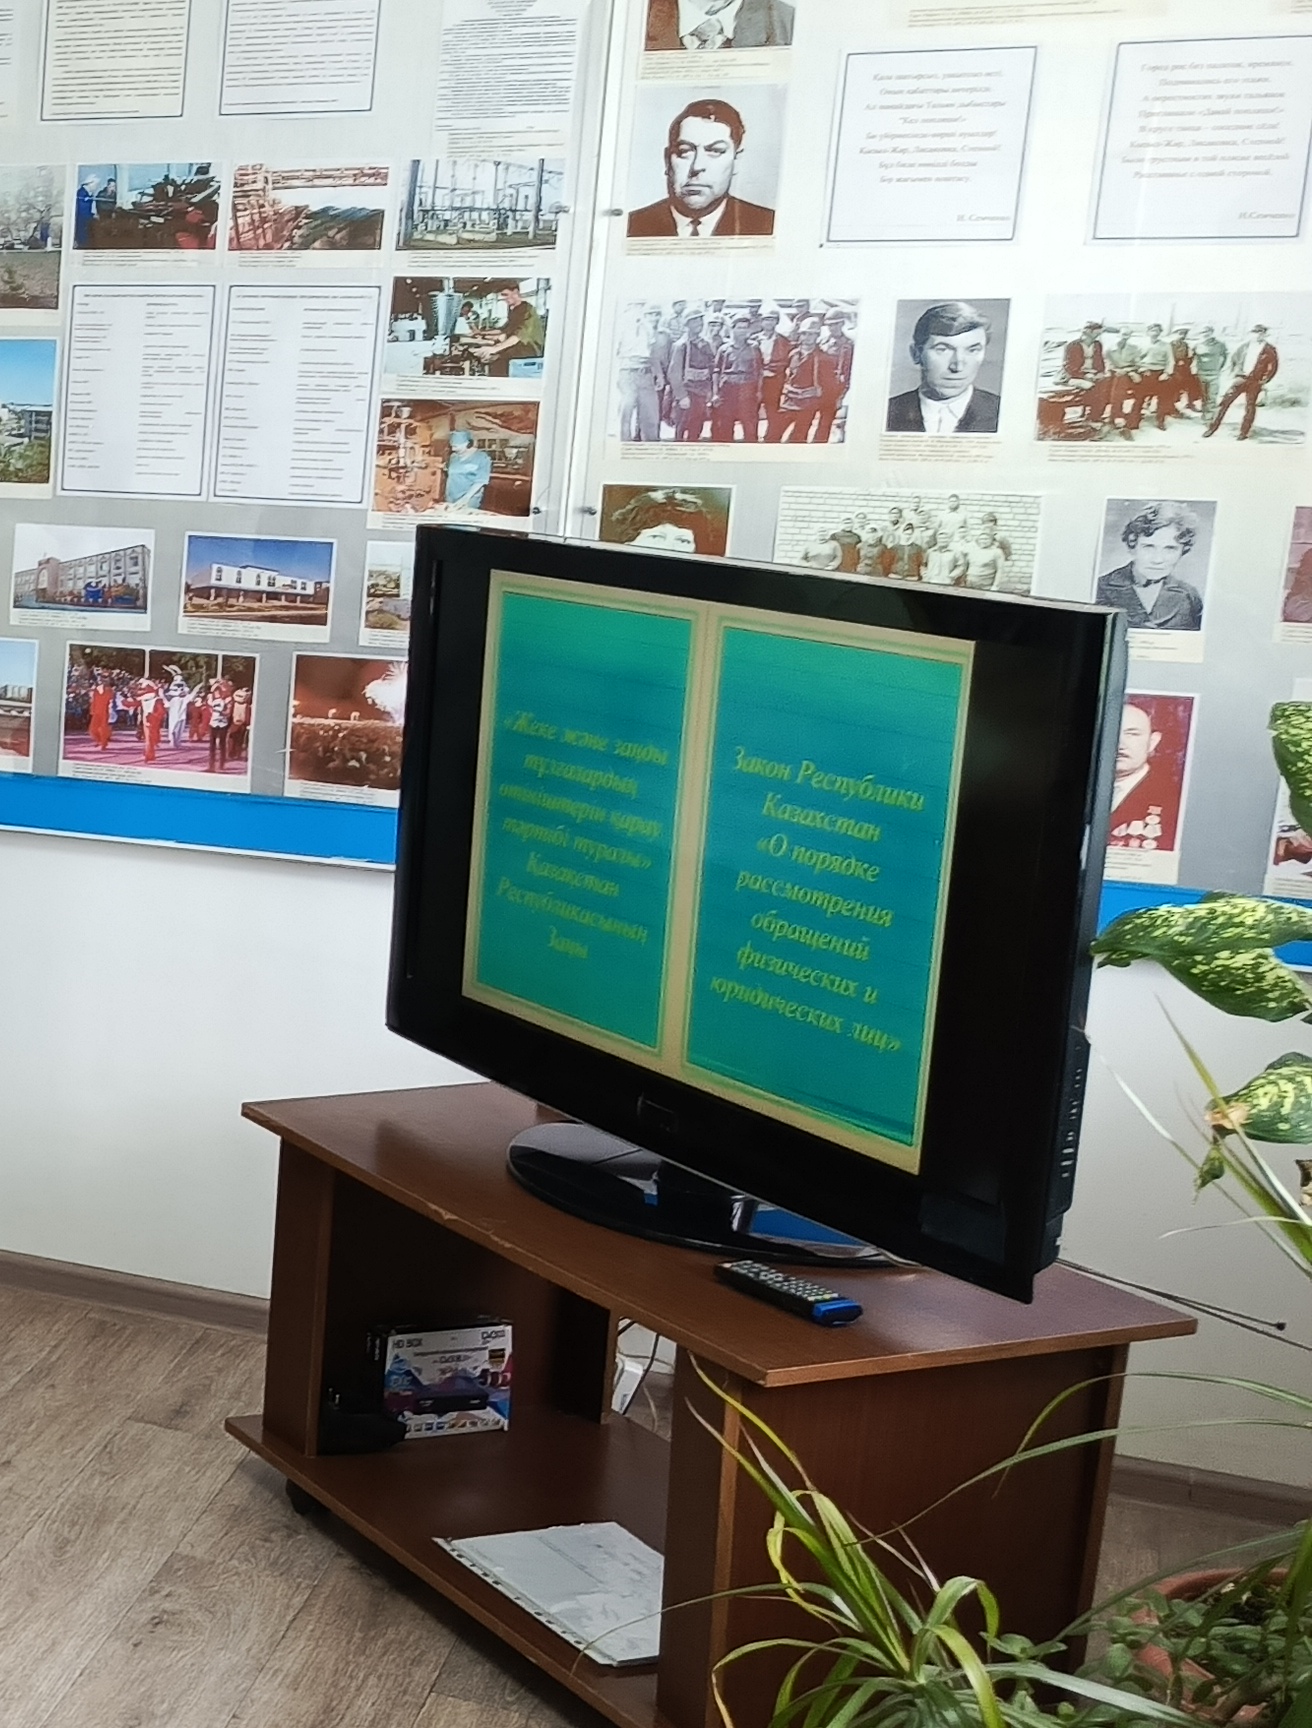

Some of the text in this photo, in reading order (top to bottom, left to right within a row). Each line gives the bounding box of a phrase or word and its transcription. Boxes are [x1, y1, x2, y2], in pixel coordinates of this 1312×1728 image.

[734, 746, 925, 811] Закон Республики
[761, 791, 882, 842] Казахстан
[756, 833, 881, 883] «О порядке
[735, 869, 895, 928] рассмотрения
[750, 910, 871, 961] обращений
[736, 940, 879, 1005] физических и
[710, 975, 903, 1054] юридических лиц»
